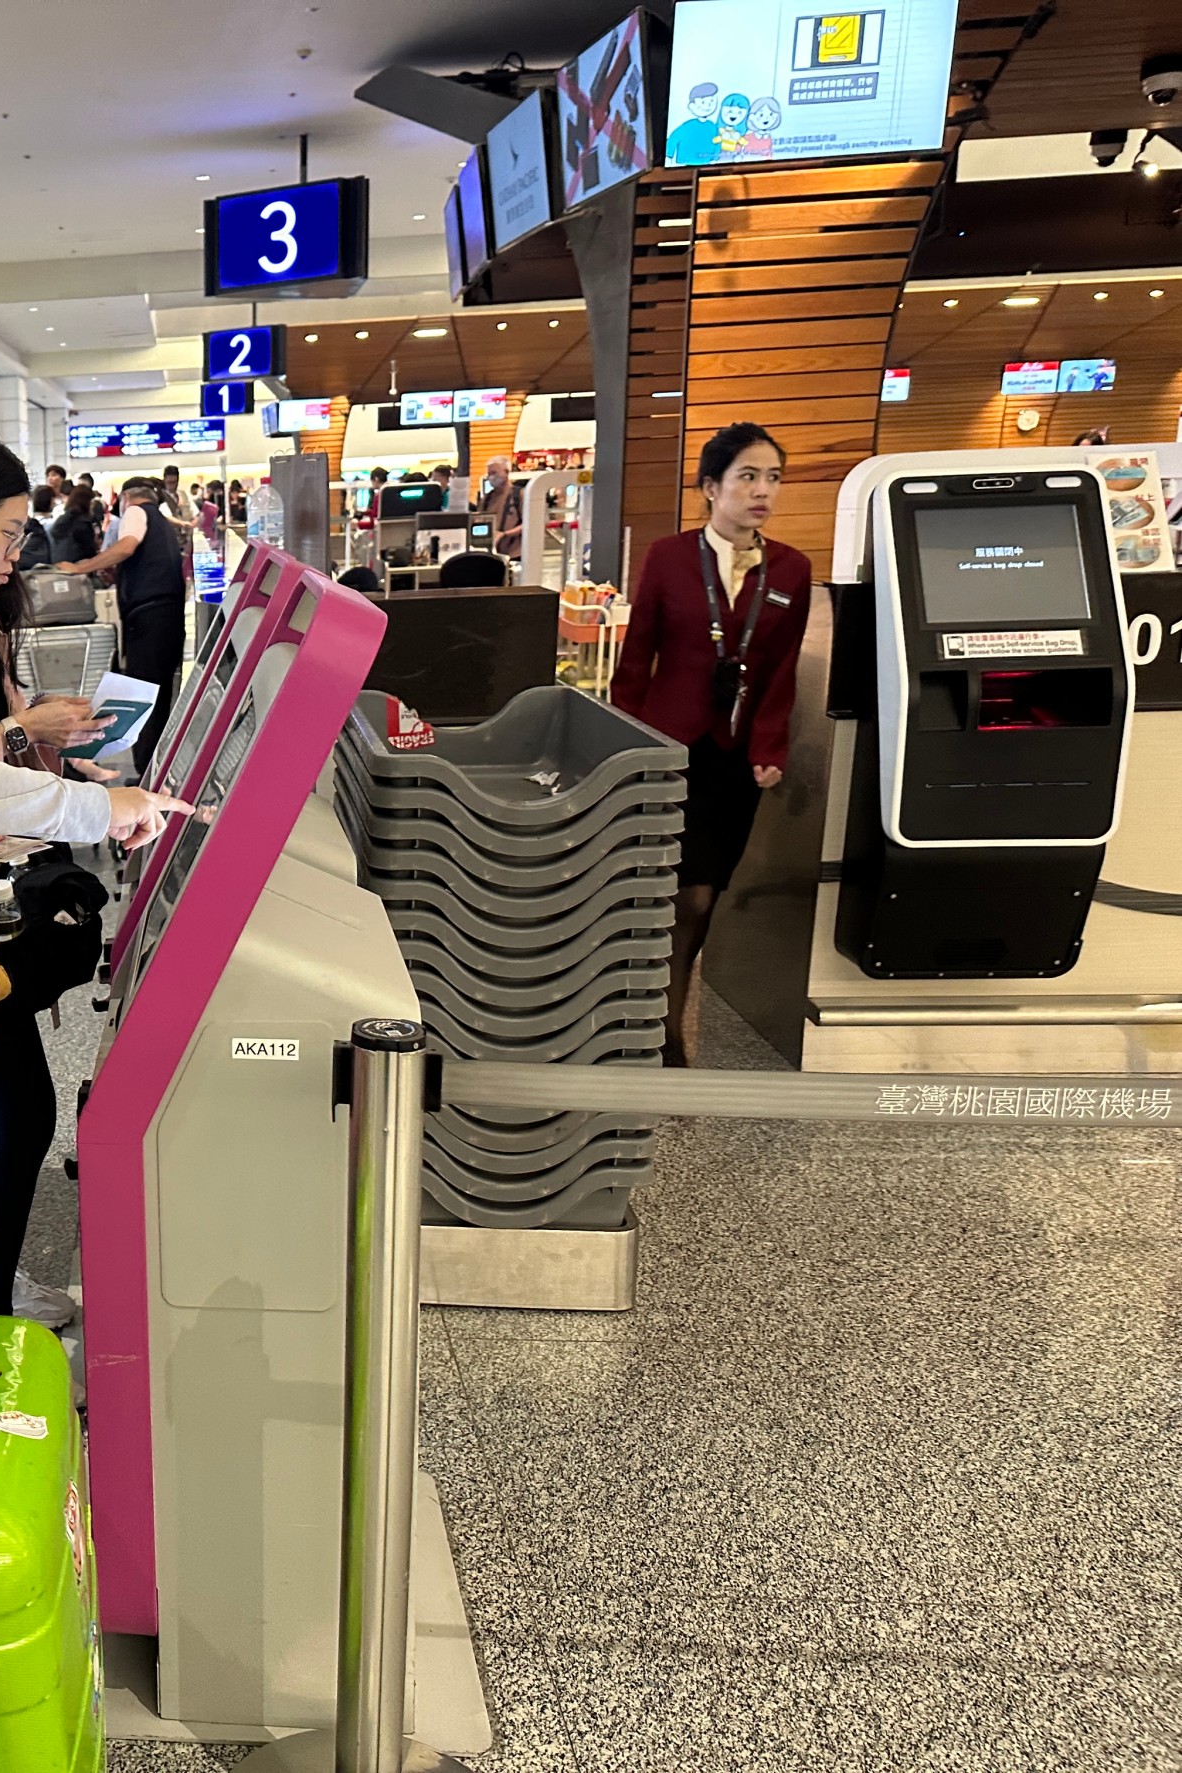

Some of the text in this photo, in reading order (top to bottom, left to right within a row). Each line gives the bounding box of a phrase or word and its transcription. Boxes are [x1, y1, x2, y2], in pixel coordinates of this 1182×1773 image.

[852, 140, 878, 148] security
[257, 200, 298, 274] 3
[228, 333, 252, 374] 2
[218, 384, 230, 413] 1
[958, 562, 992, 570] Self-service
[993, 562, 1006, 570] bag
[1007, 561, 1023, 569] drop
[1006, 640, 1044, 648] Self-service
[1045, 640, 1059, 648] Bag
[234, 1042, 296, 1057] AKA112
[874, 1084, 1173, 1120] 臺灣桃園國際機場
